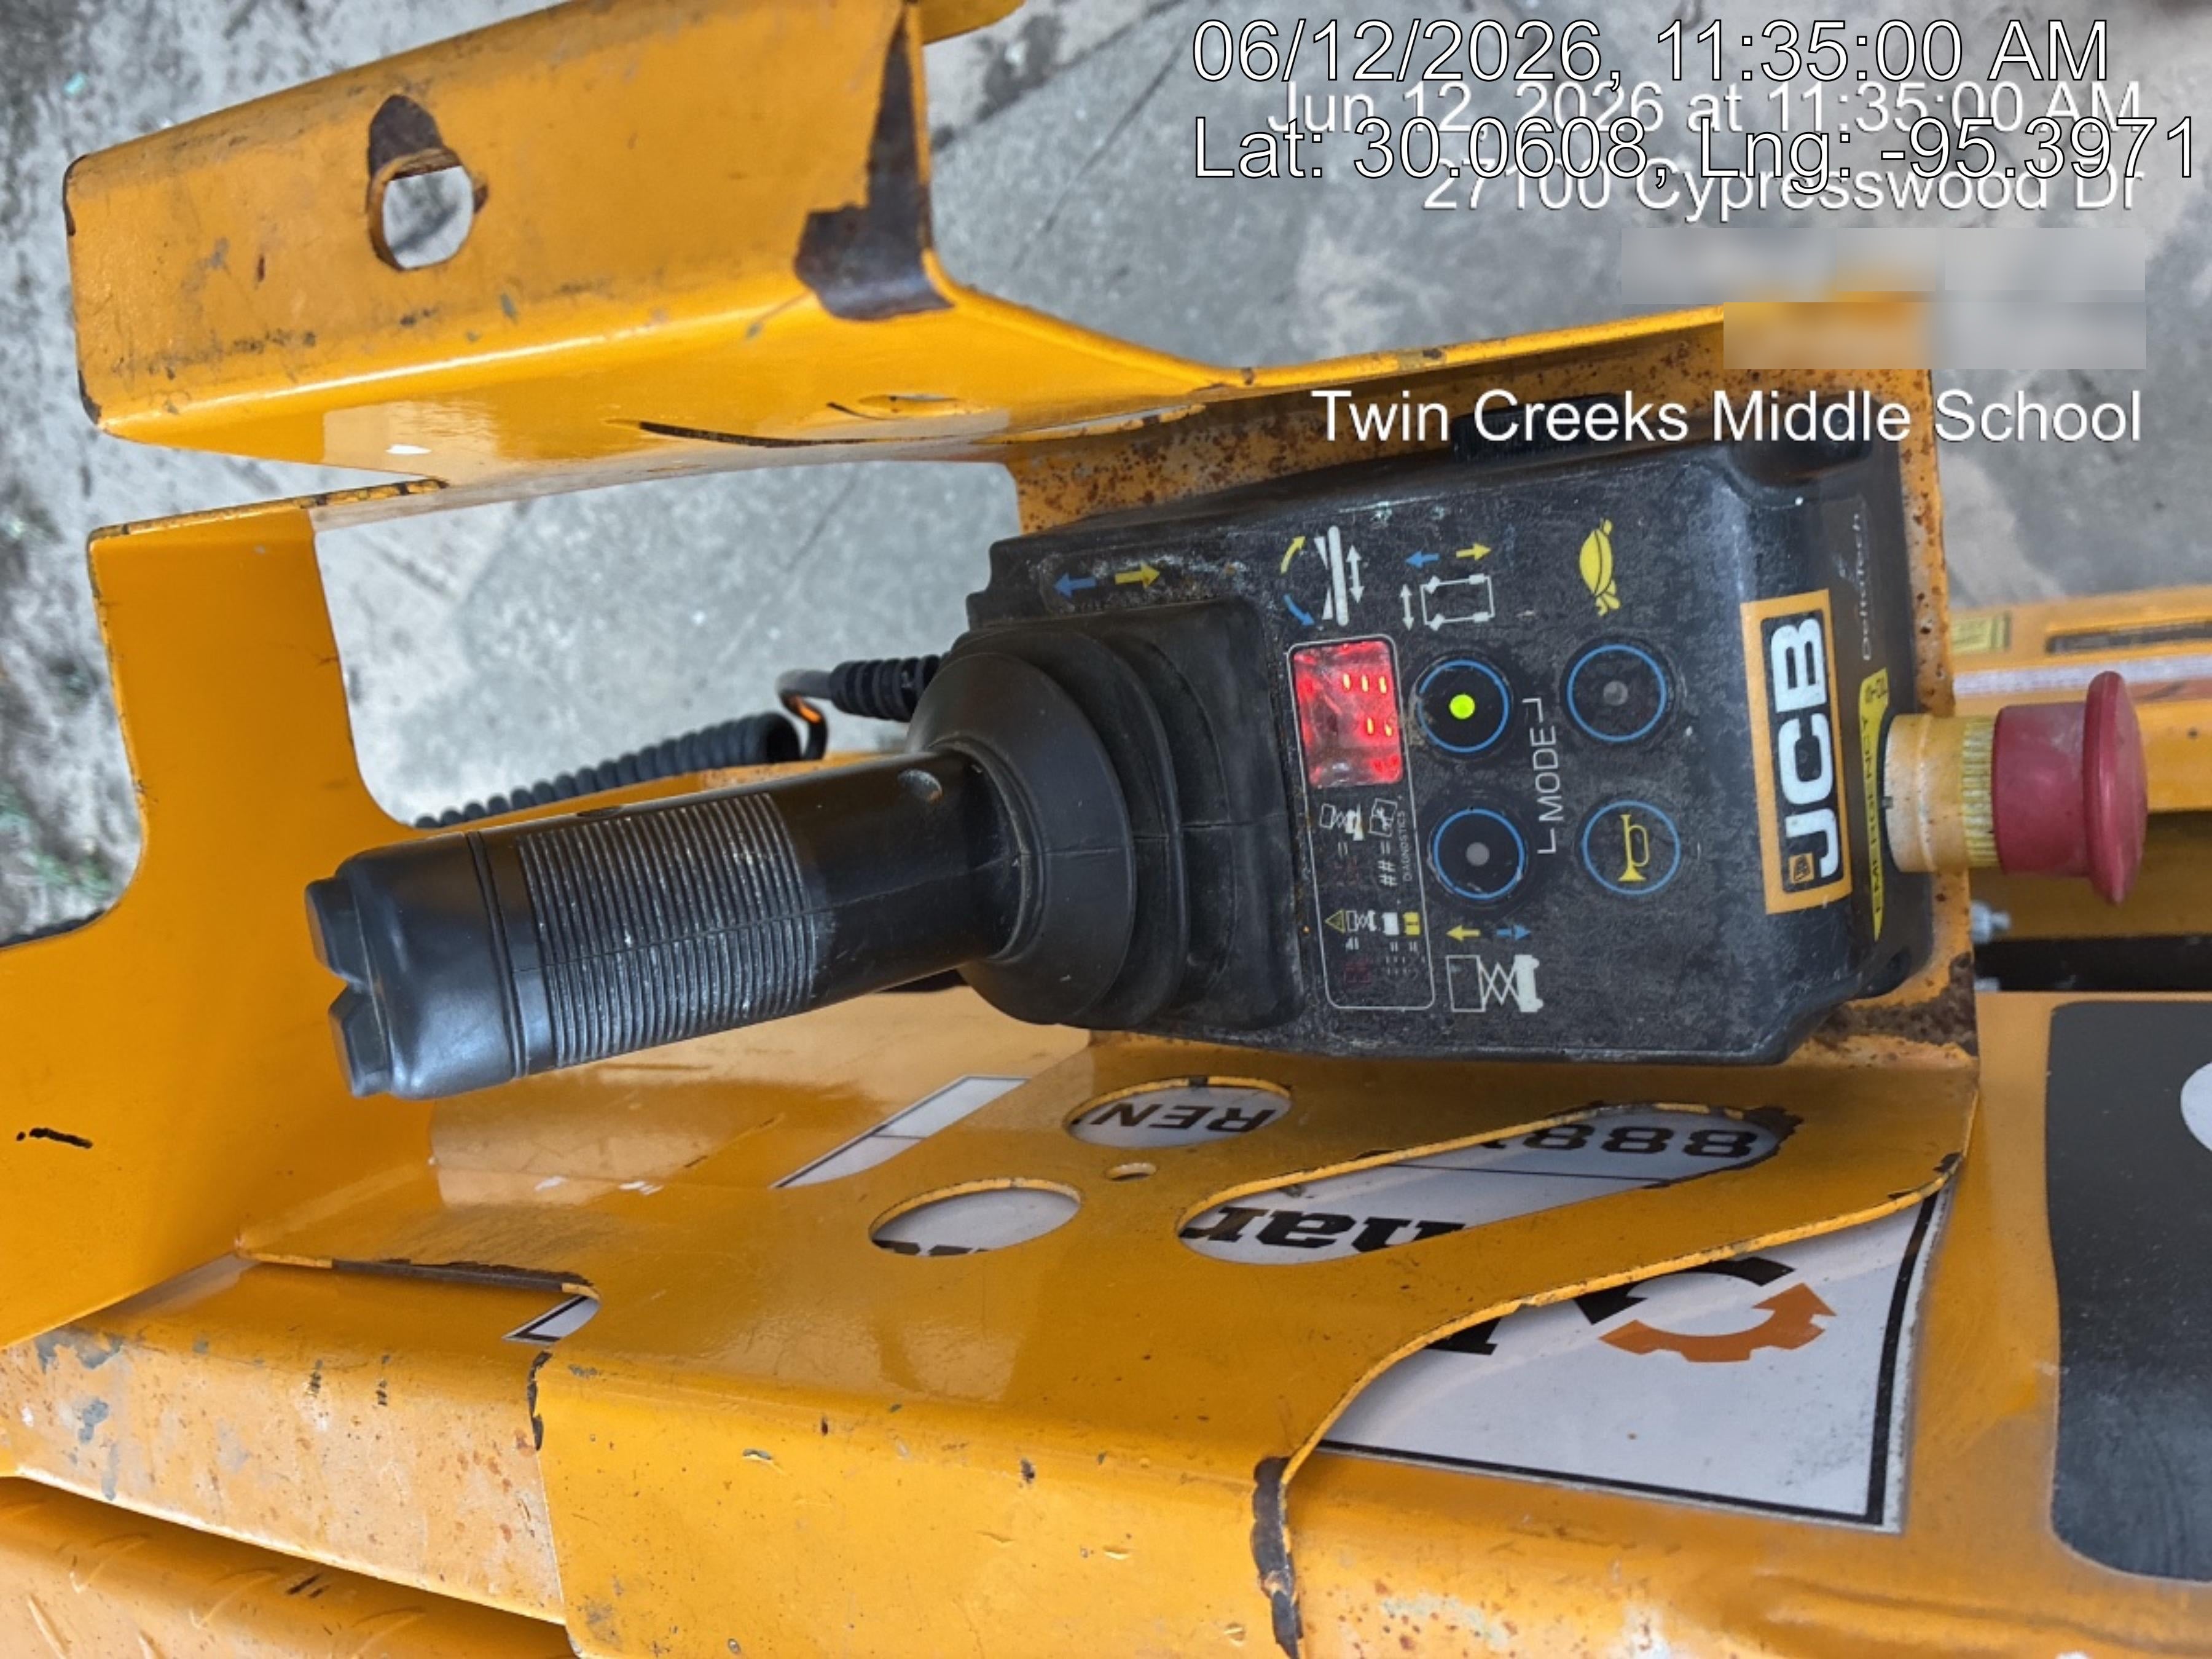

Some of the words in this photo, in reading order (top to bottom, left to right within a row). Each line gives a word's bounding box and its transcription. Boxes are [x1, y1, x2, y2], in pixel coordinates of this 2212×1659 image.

[1530, 726, 1564, 823] MODE
[1770, 617, 1839, 879] JCB
[1862, 717, 1882, 914] EMERGENCY
[1071, 1103, 1276, 1132] REN
[1480, 1123, 1759, 1158] 888
